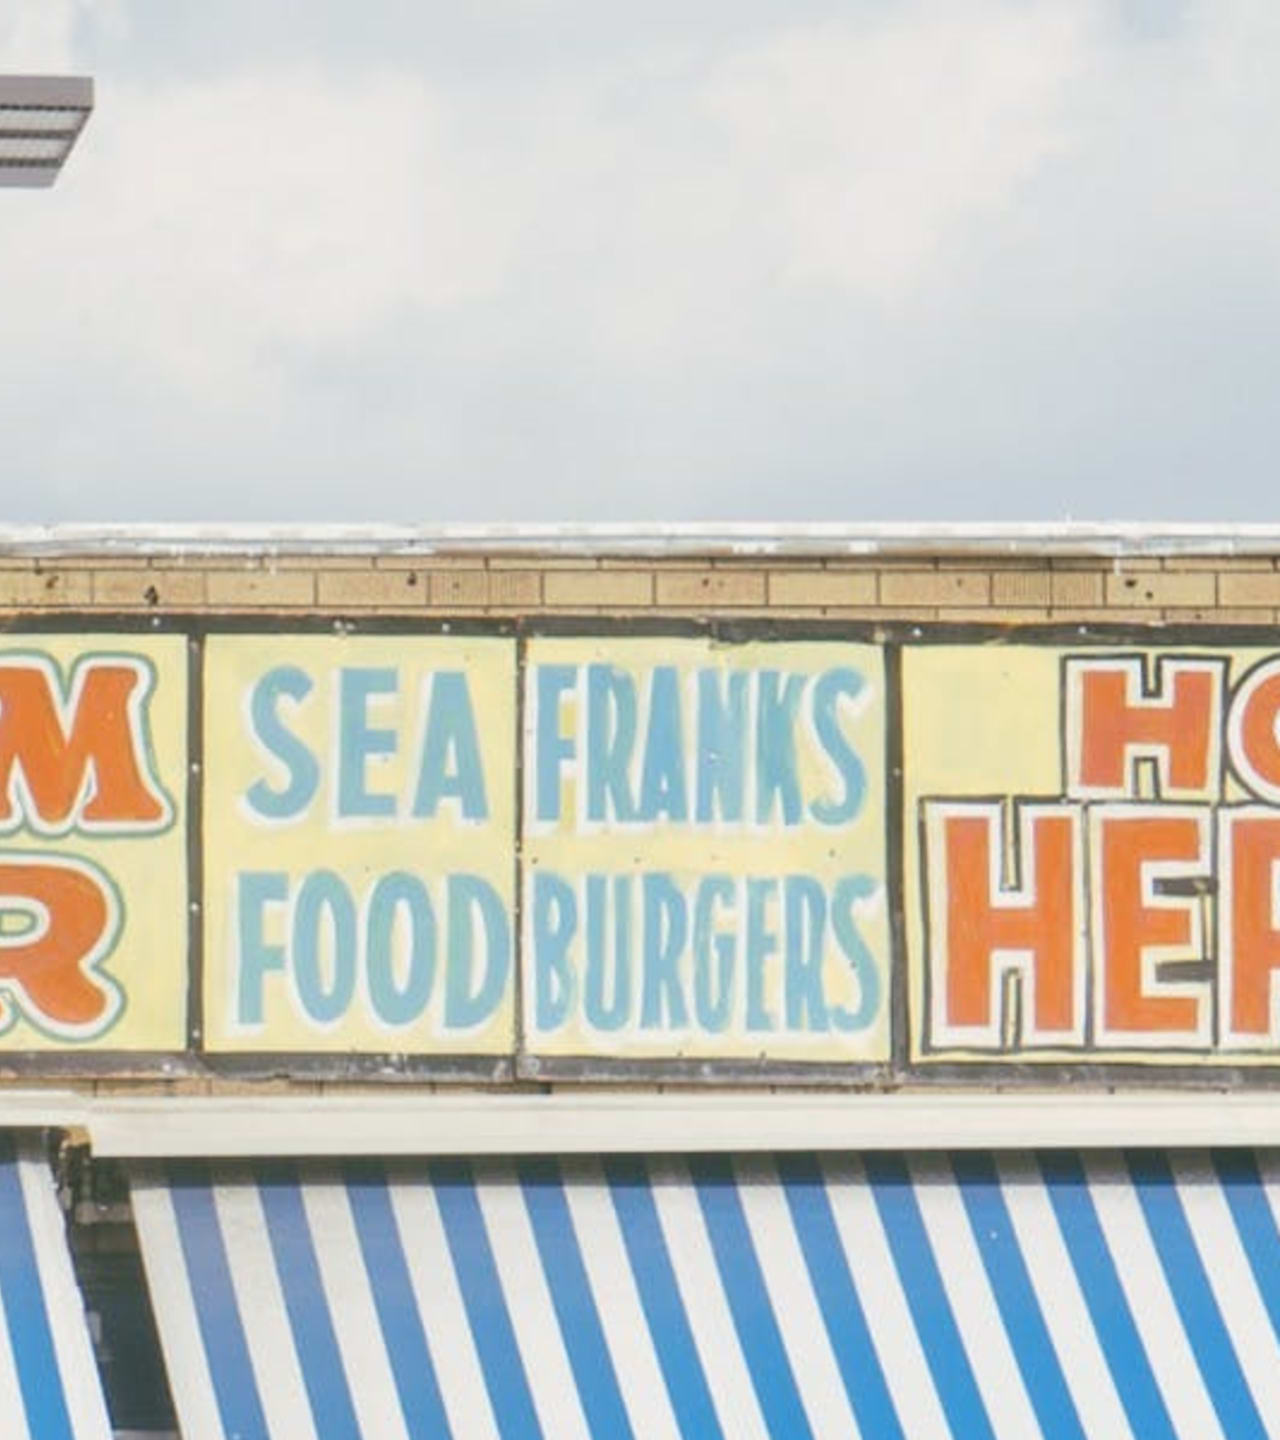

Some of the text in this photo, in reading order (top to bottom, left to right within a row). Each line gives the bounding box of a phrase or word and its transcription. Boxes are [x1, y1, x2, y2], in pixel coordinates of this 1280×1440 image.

[244, 664, 489, 826] SEA
[530, 660, 872, 832] FRANKS
[233, 869, 514, 1034] FOOD
[530, 869, 888, 1038] BURGERS
